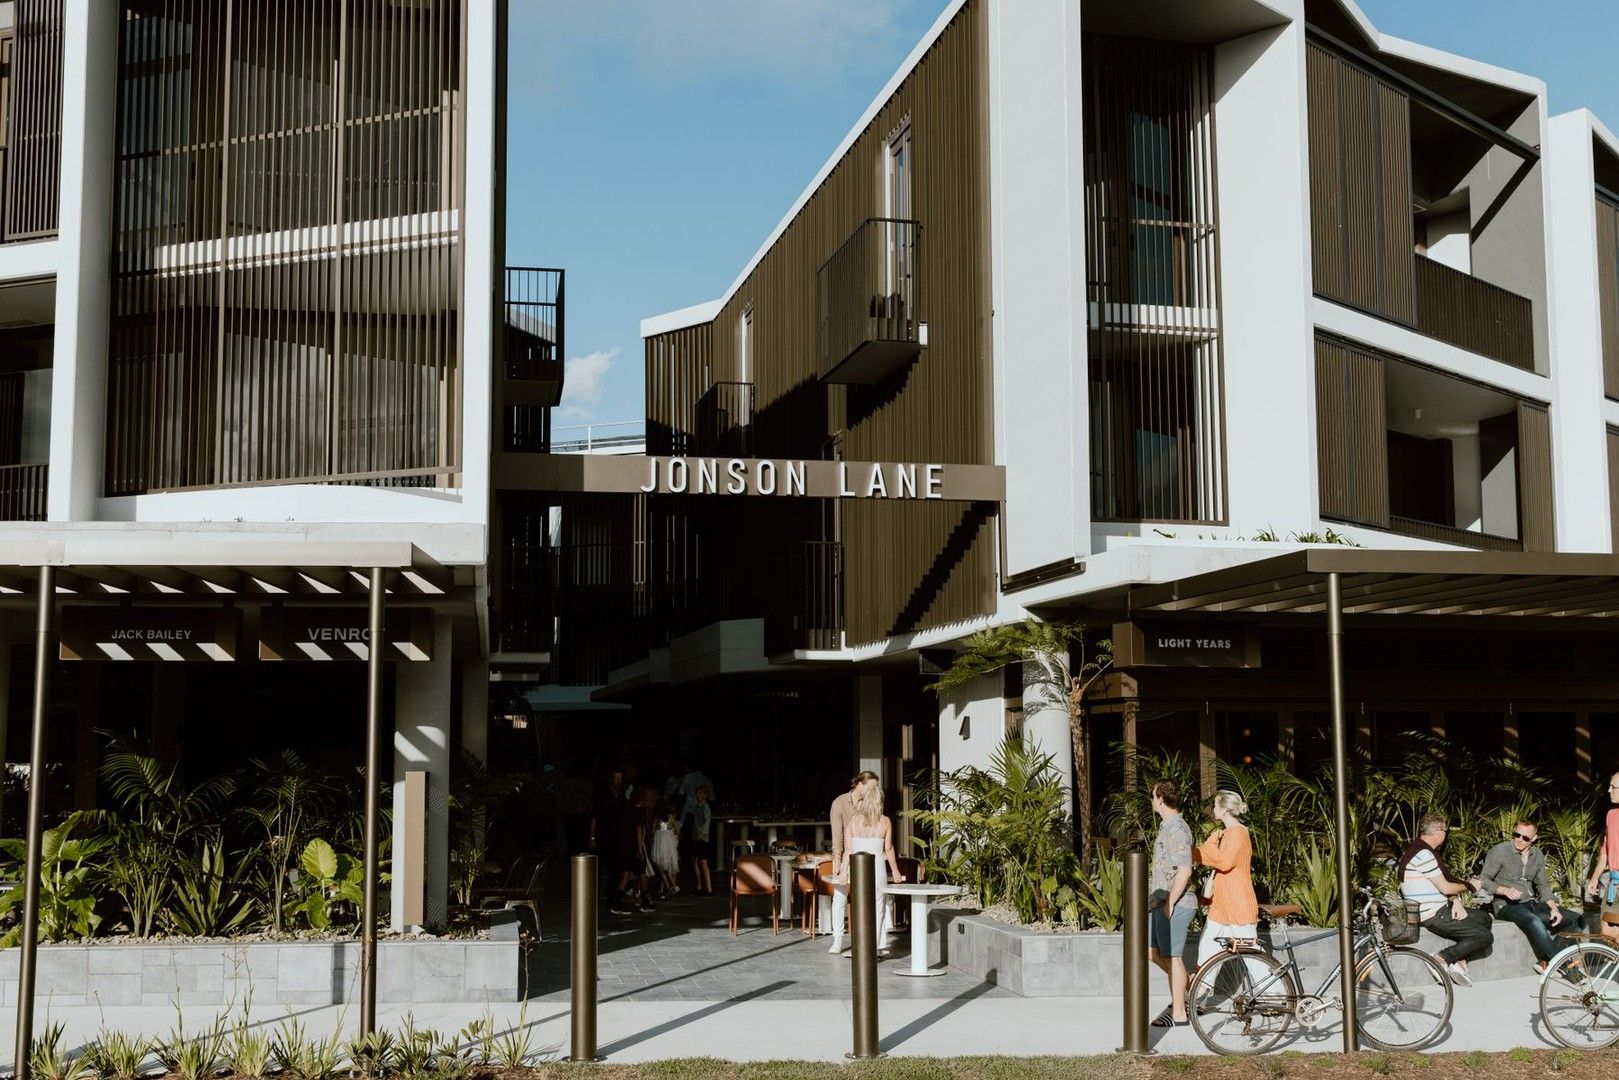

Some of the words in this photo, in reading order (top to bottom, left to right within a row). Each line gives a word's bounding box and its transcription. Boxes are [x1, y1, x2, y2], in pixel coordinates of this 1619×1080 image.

[640, 456, 805, 495] JONSON
[839, 461, 942, 498] LANE
[111, 629, 144, 640] JACK
[146, 629, 192, 640] BAILEY
[307, 627, 386, 641] VENRO
[1158, 638, 1192, 648] LIGHT
[1195, 639, 1231, 649] YEARS
